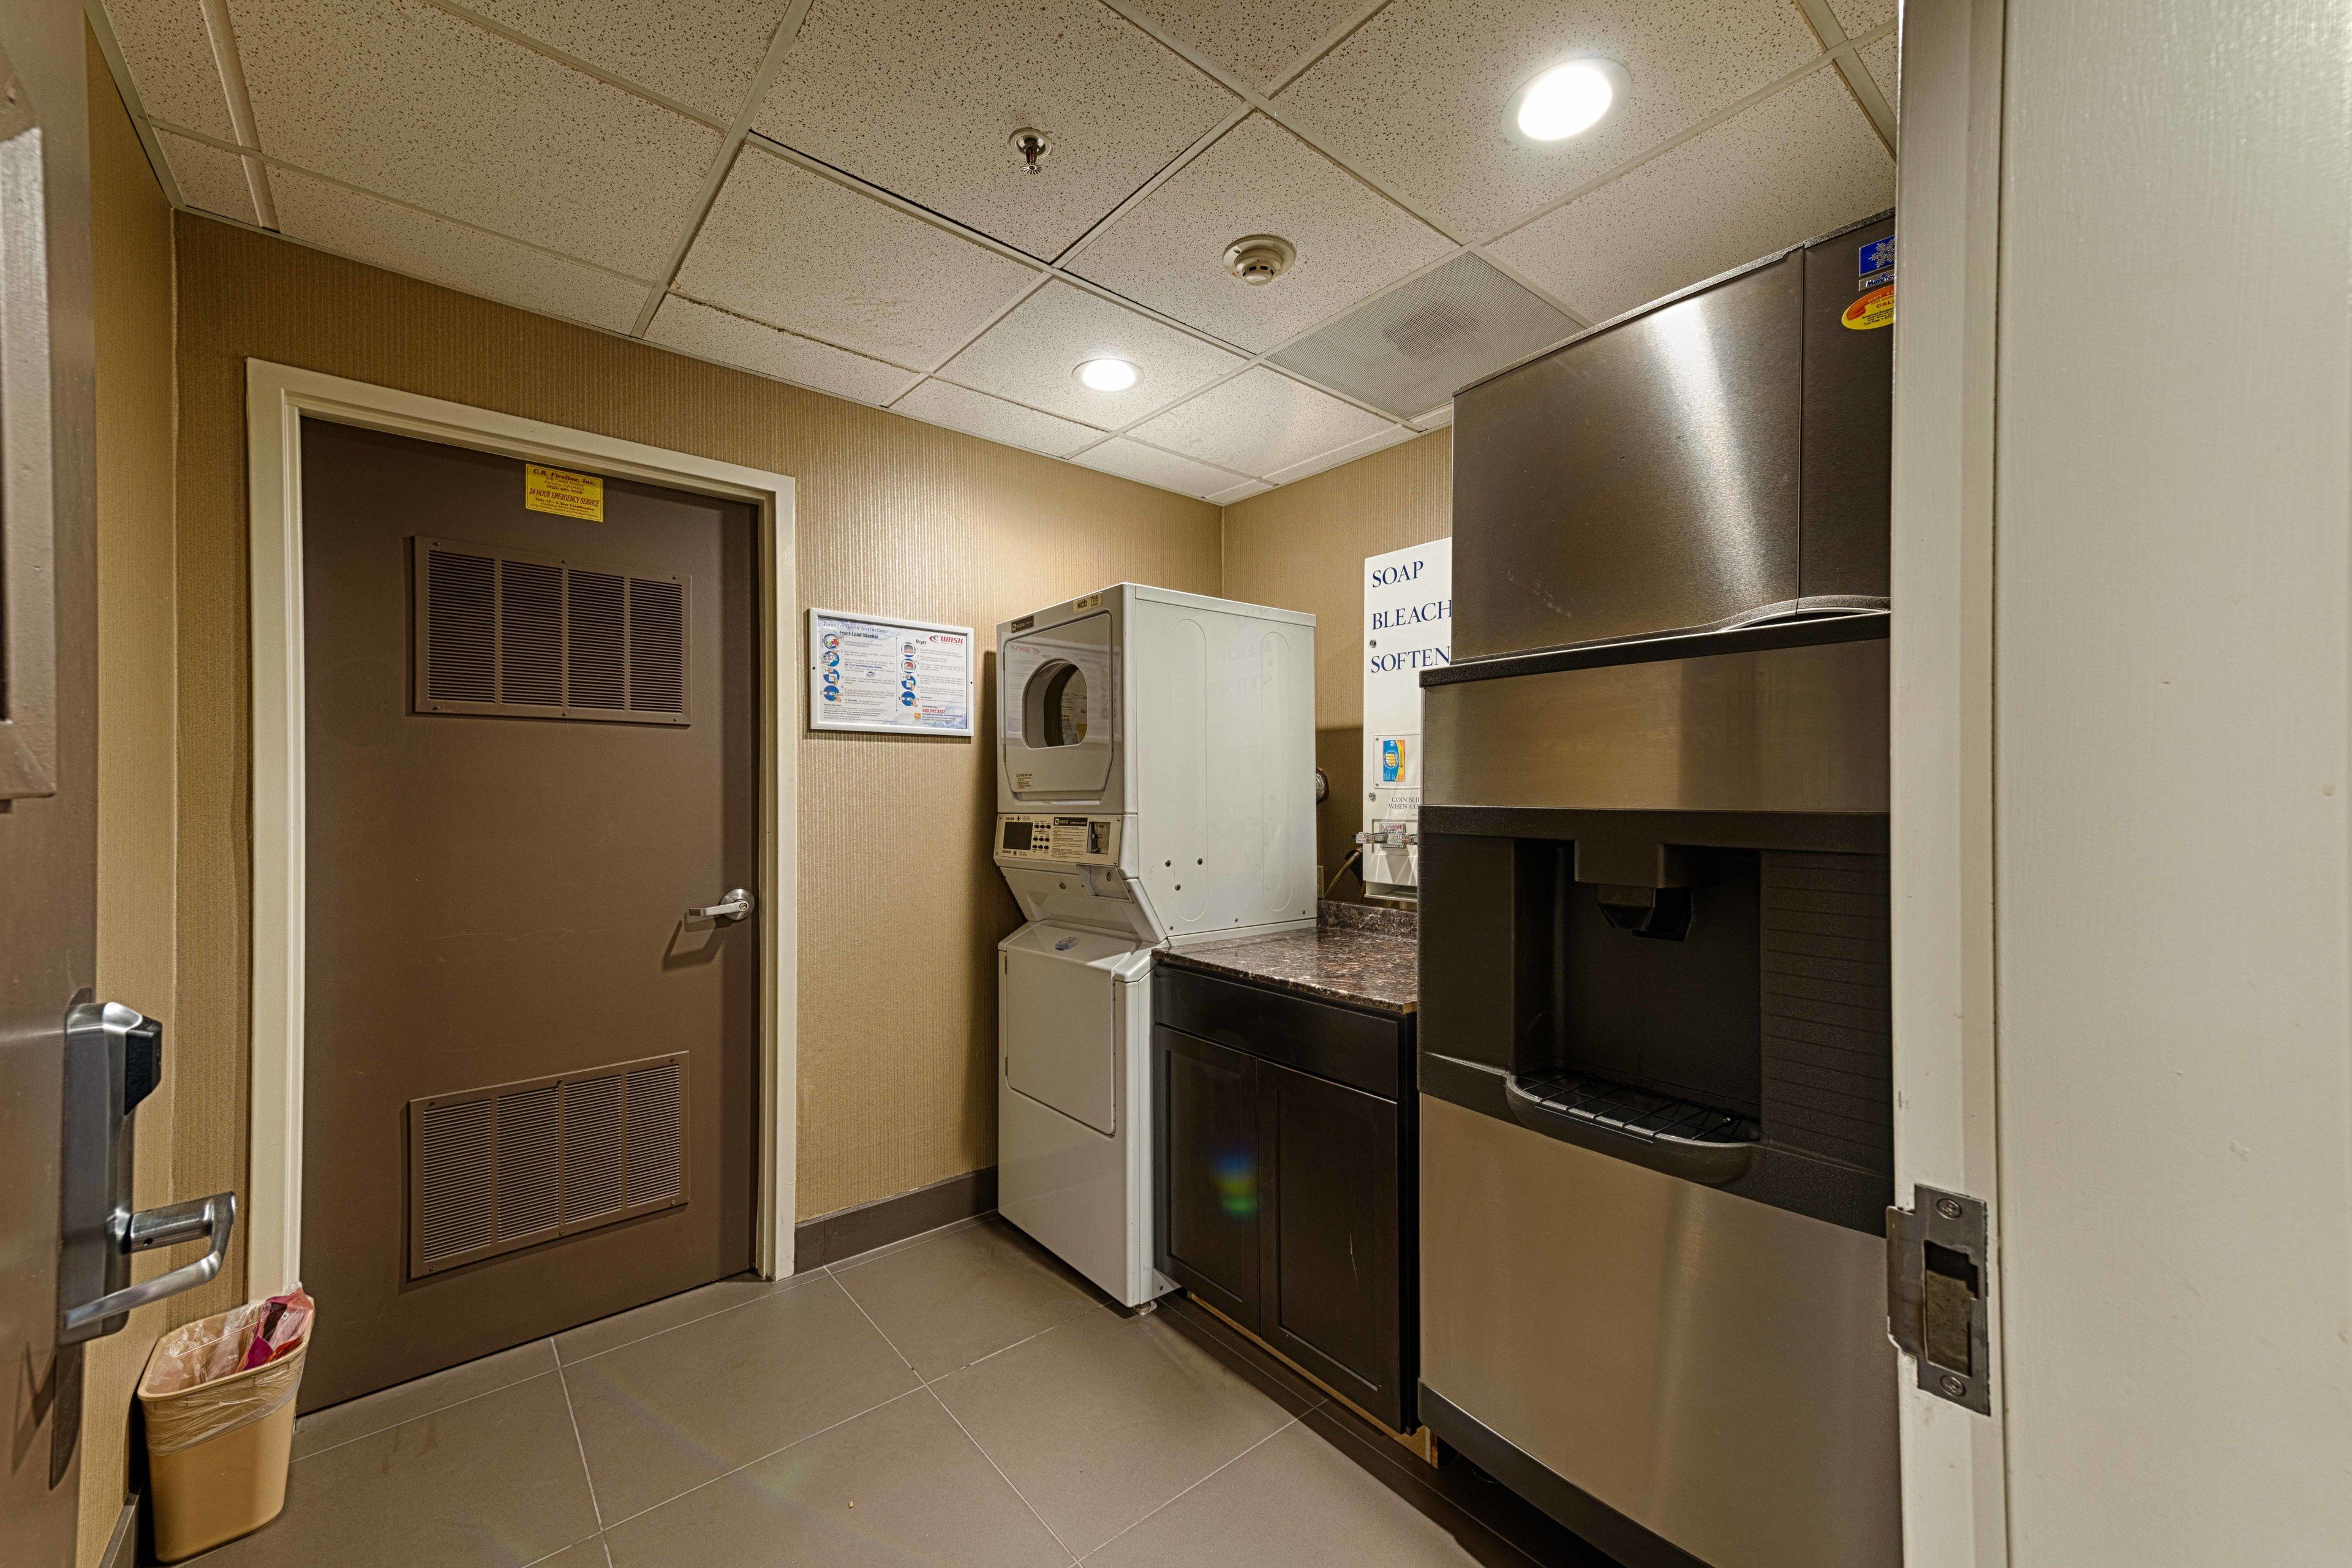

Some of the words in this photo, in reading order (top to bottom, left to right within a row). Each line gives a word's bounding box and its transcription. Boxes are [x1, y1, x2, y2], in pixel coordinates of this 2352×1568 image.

[551, 472, 580, 483] Fireline,
[536, 489, 551, 497] HOUR
[551, 492, 580, 503] EMERGENCY
[580, 497, 600, 507] SERVICE
[1372, 561, 1423, 588] SOAP
[1090, 595, 1099, 604] 706
[1372, 600, 1452, 630] BLEACH
[941, 636, 963, 644] WASH
[1371, 646, 1450, 673] SOFTEN
